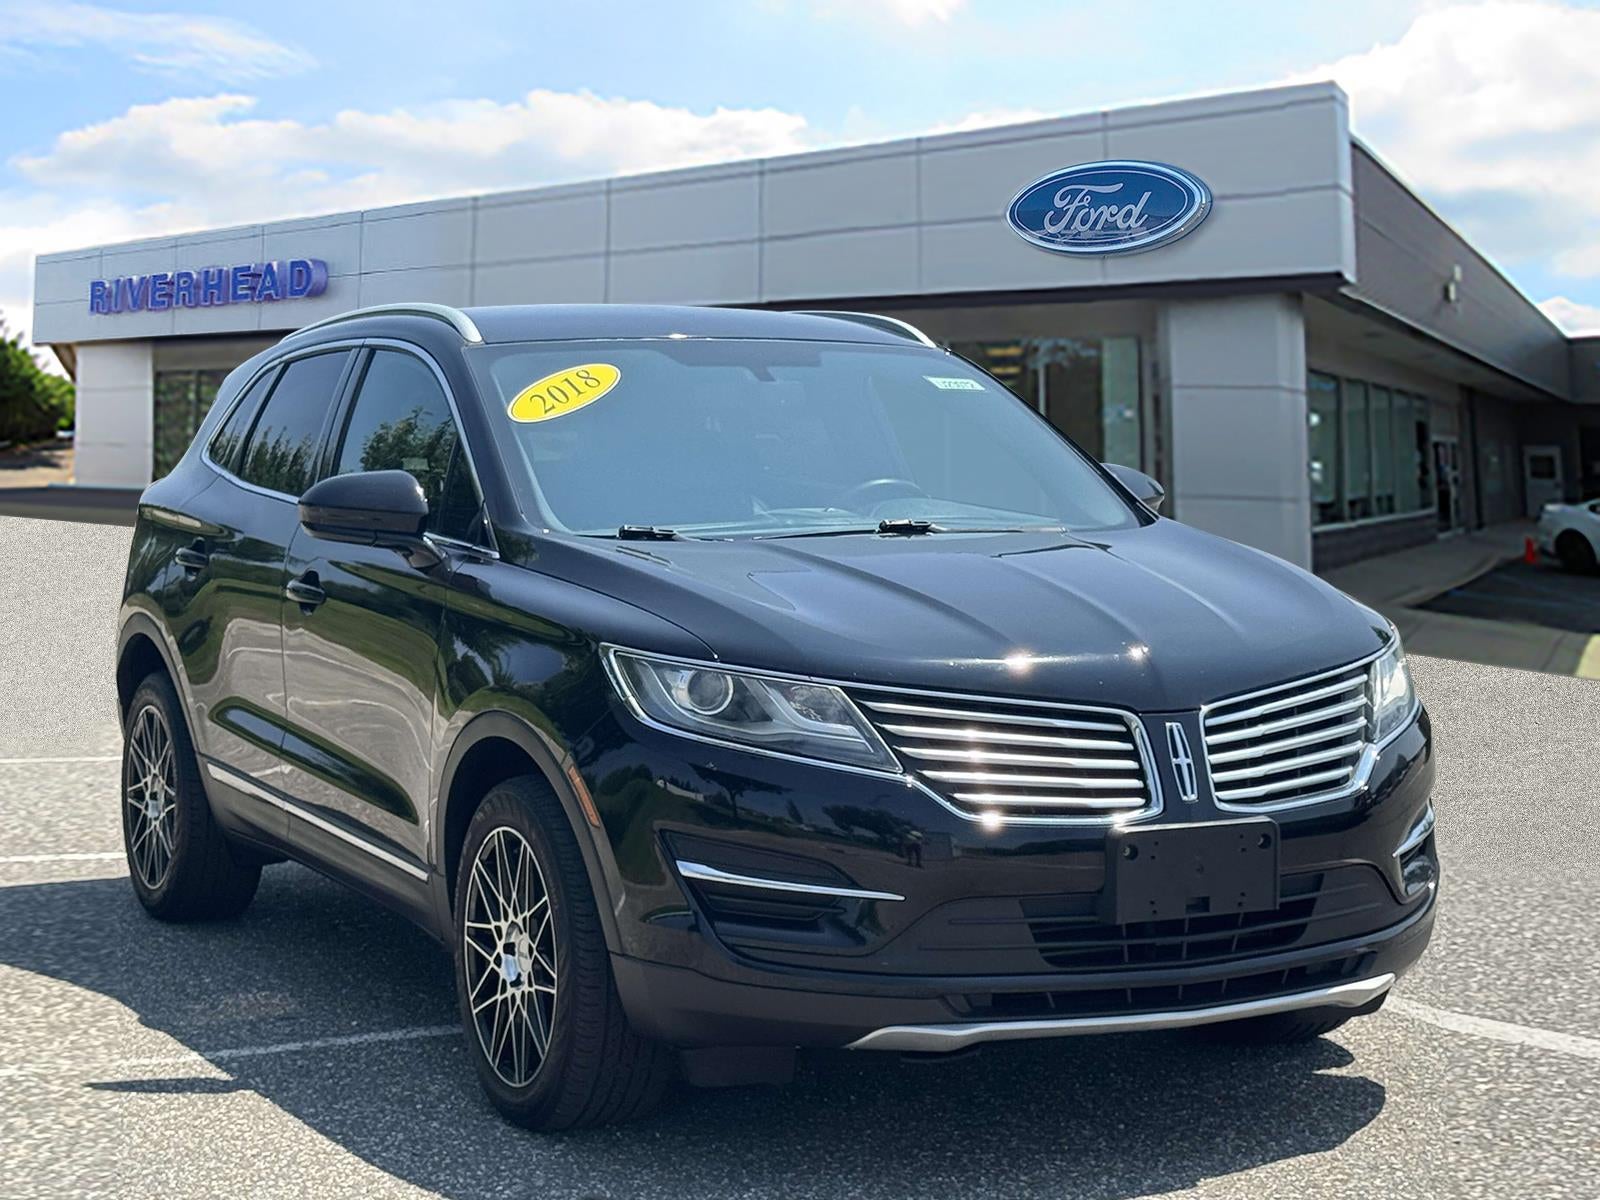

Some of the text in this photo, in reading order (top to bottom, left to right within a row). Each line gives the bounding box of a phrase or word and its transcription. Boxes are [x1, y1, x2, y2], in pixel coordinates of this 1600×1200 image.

[1044, 183, 1152, 233] Ford
[89, 259, 325, 315] RIVERHEAD
[529, 369, 601, 414] 2018
